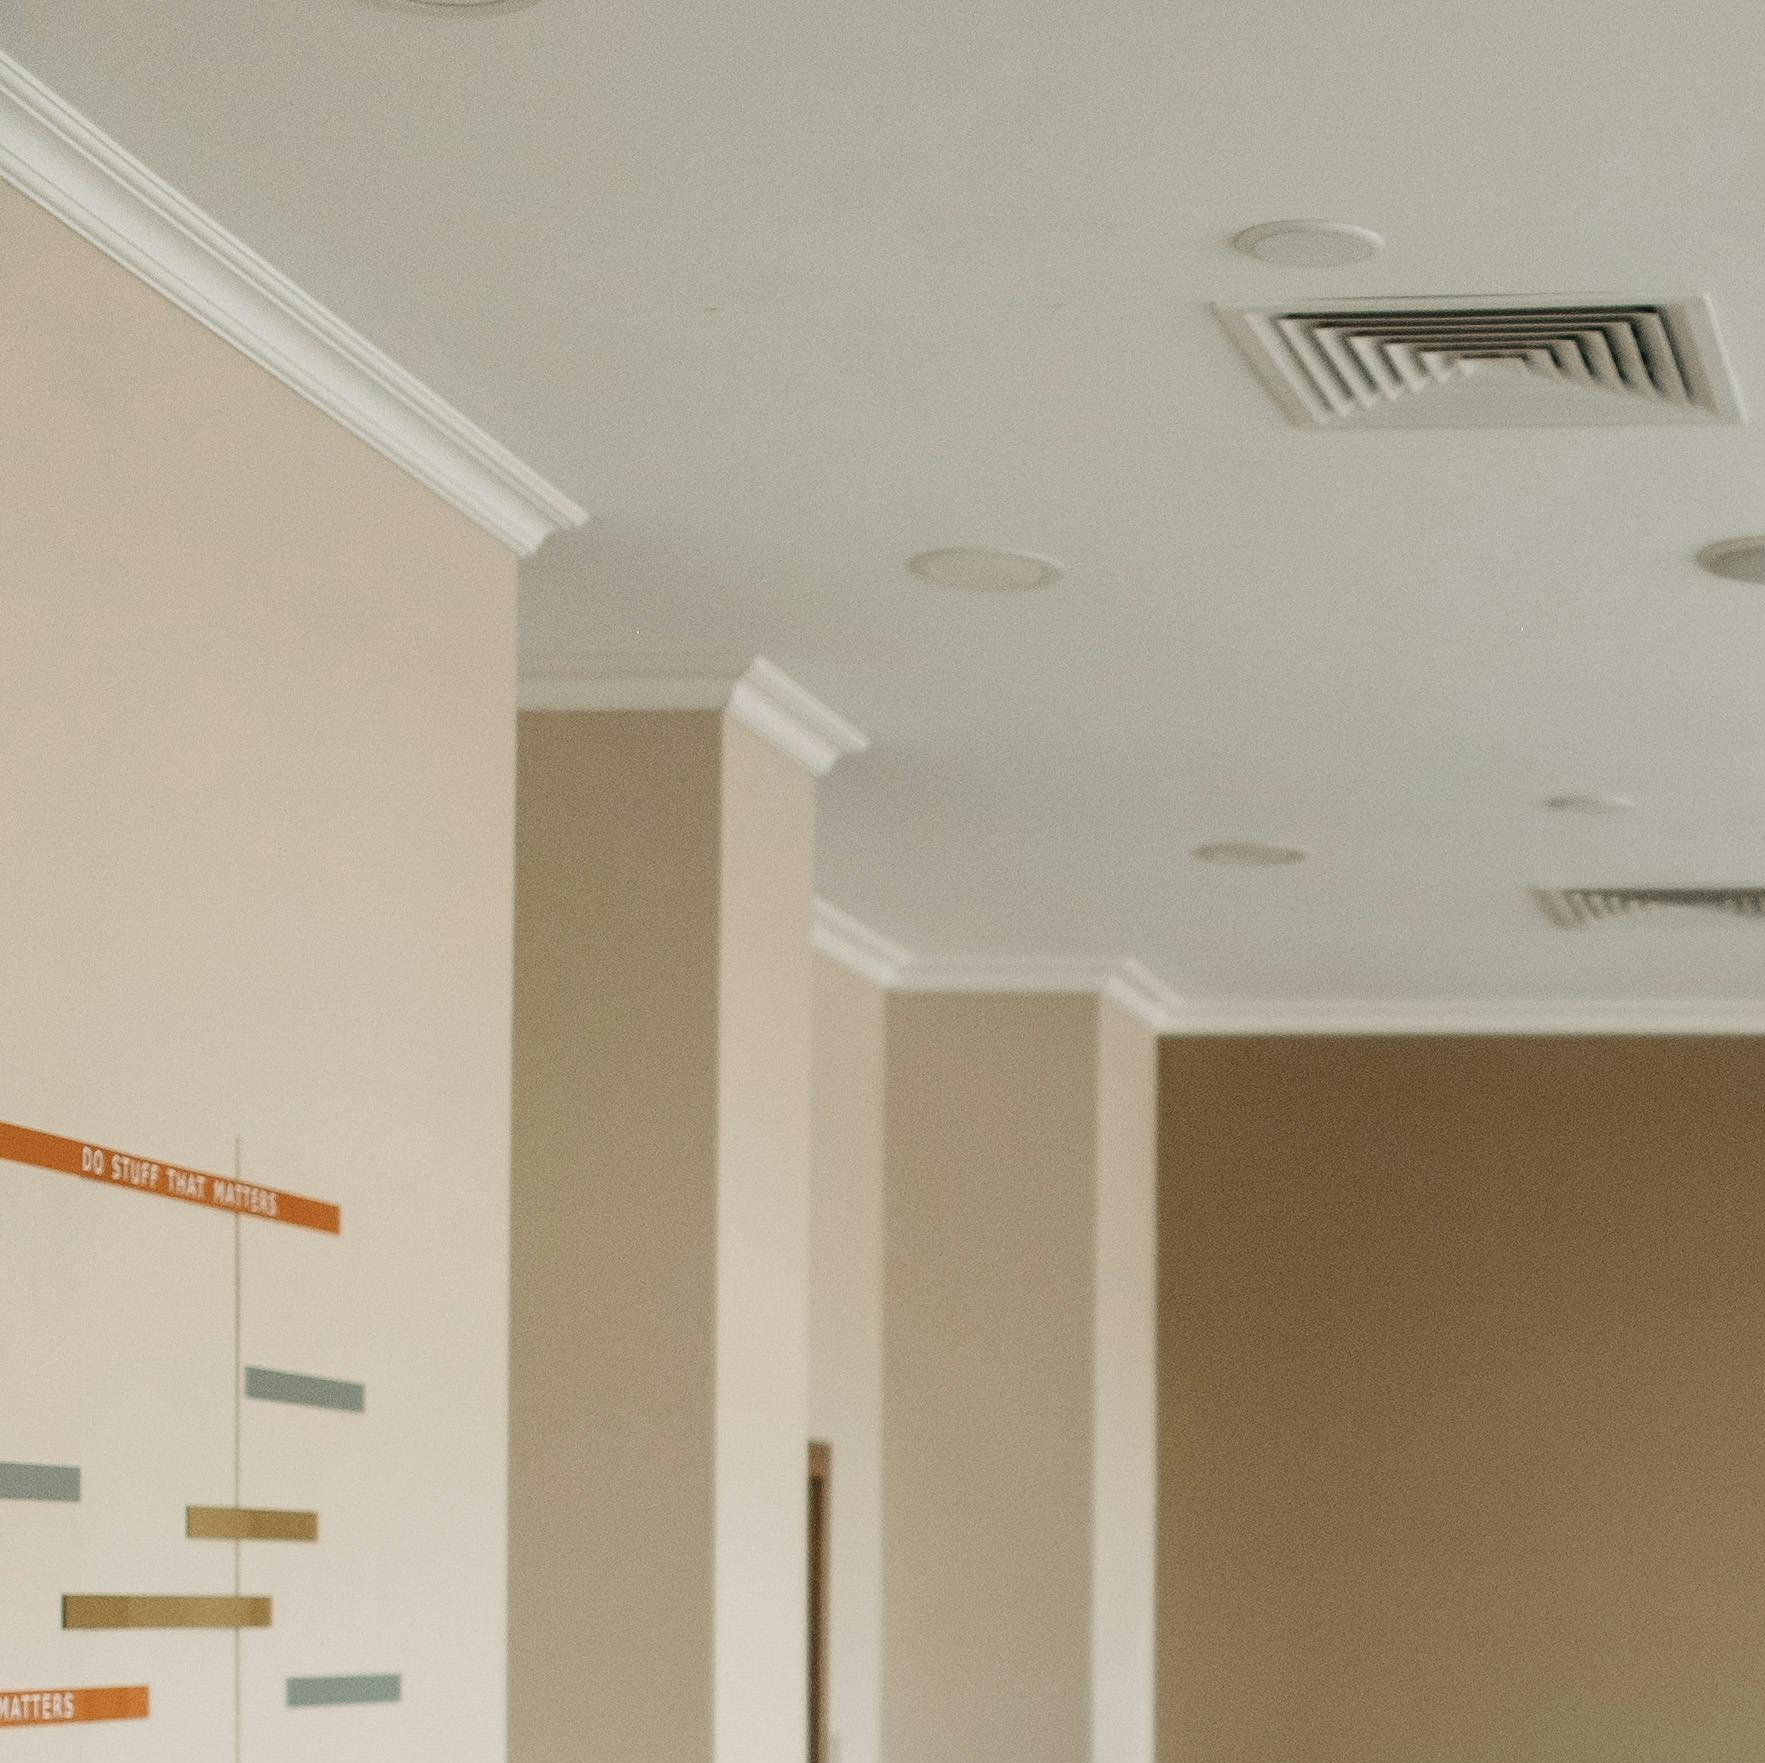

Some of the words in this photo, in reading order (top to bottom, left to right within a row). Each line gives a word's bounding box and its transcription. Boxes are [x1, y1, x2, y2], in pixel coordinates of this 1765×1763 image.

[81, 1146, 104, 1176] DO
[111, 1154, 160, 1184] STUFF
[166, 1168, 206, 1197] THAT
[213, 1179, 278, 1217] MATTERS
